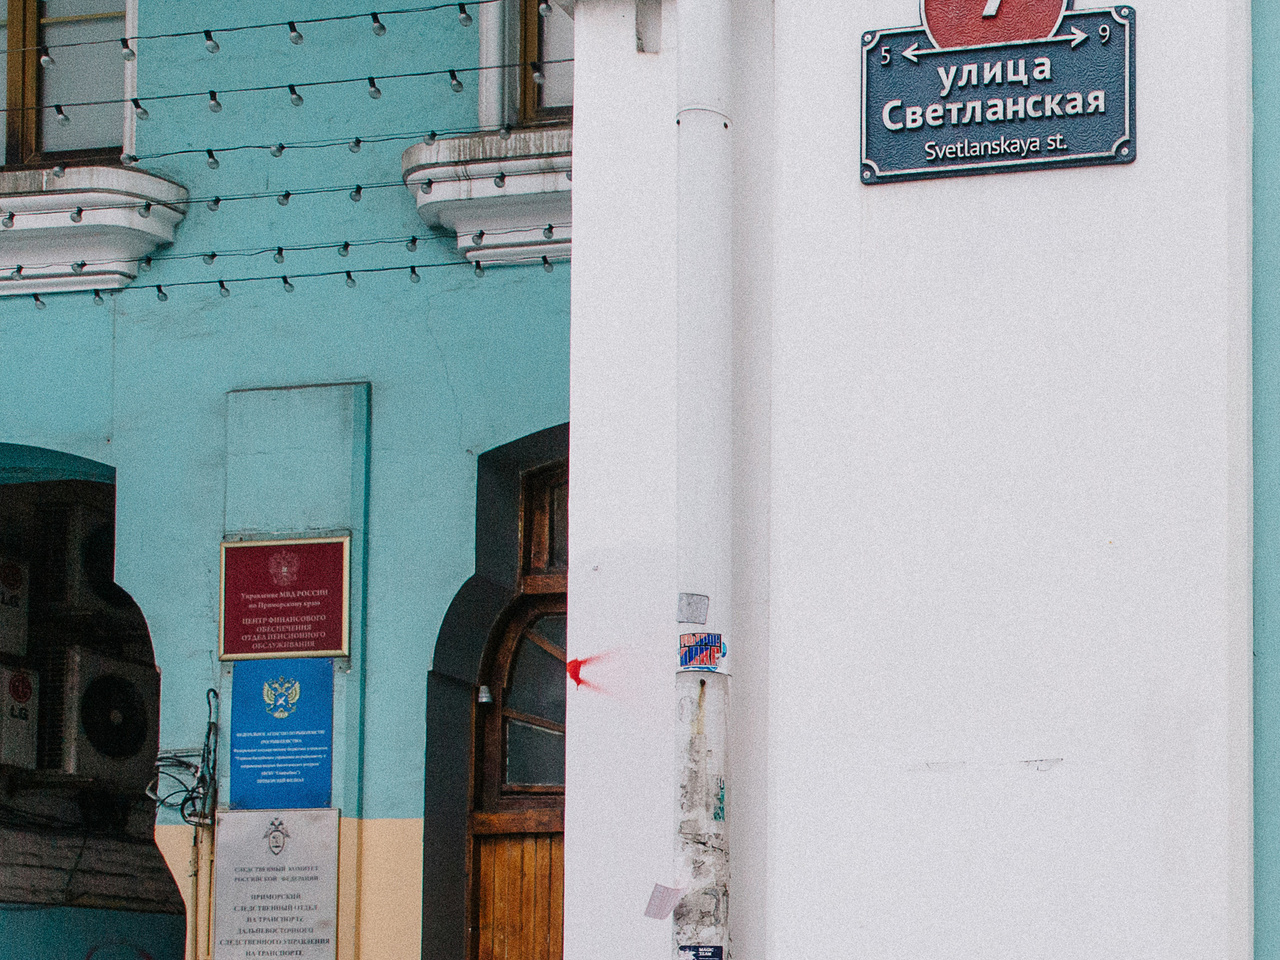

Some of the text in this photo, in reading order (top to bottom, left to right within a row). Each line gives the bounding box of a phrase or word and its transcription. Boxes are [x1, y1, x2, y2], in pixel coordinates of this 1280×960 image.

[1099, 24, 1111, 44] 9
[880, 46, 891, 65] 5
[937, 56, 1052, 97] улица
[882, 90, 1106, 131] Светланская
[924, 133, 1068, 161] Svetlanskaya st.
[10, 704, 30, 721] LG
